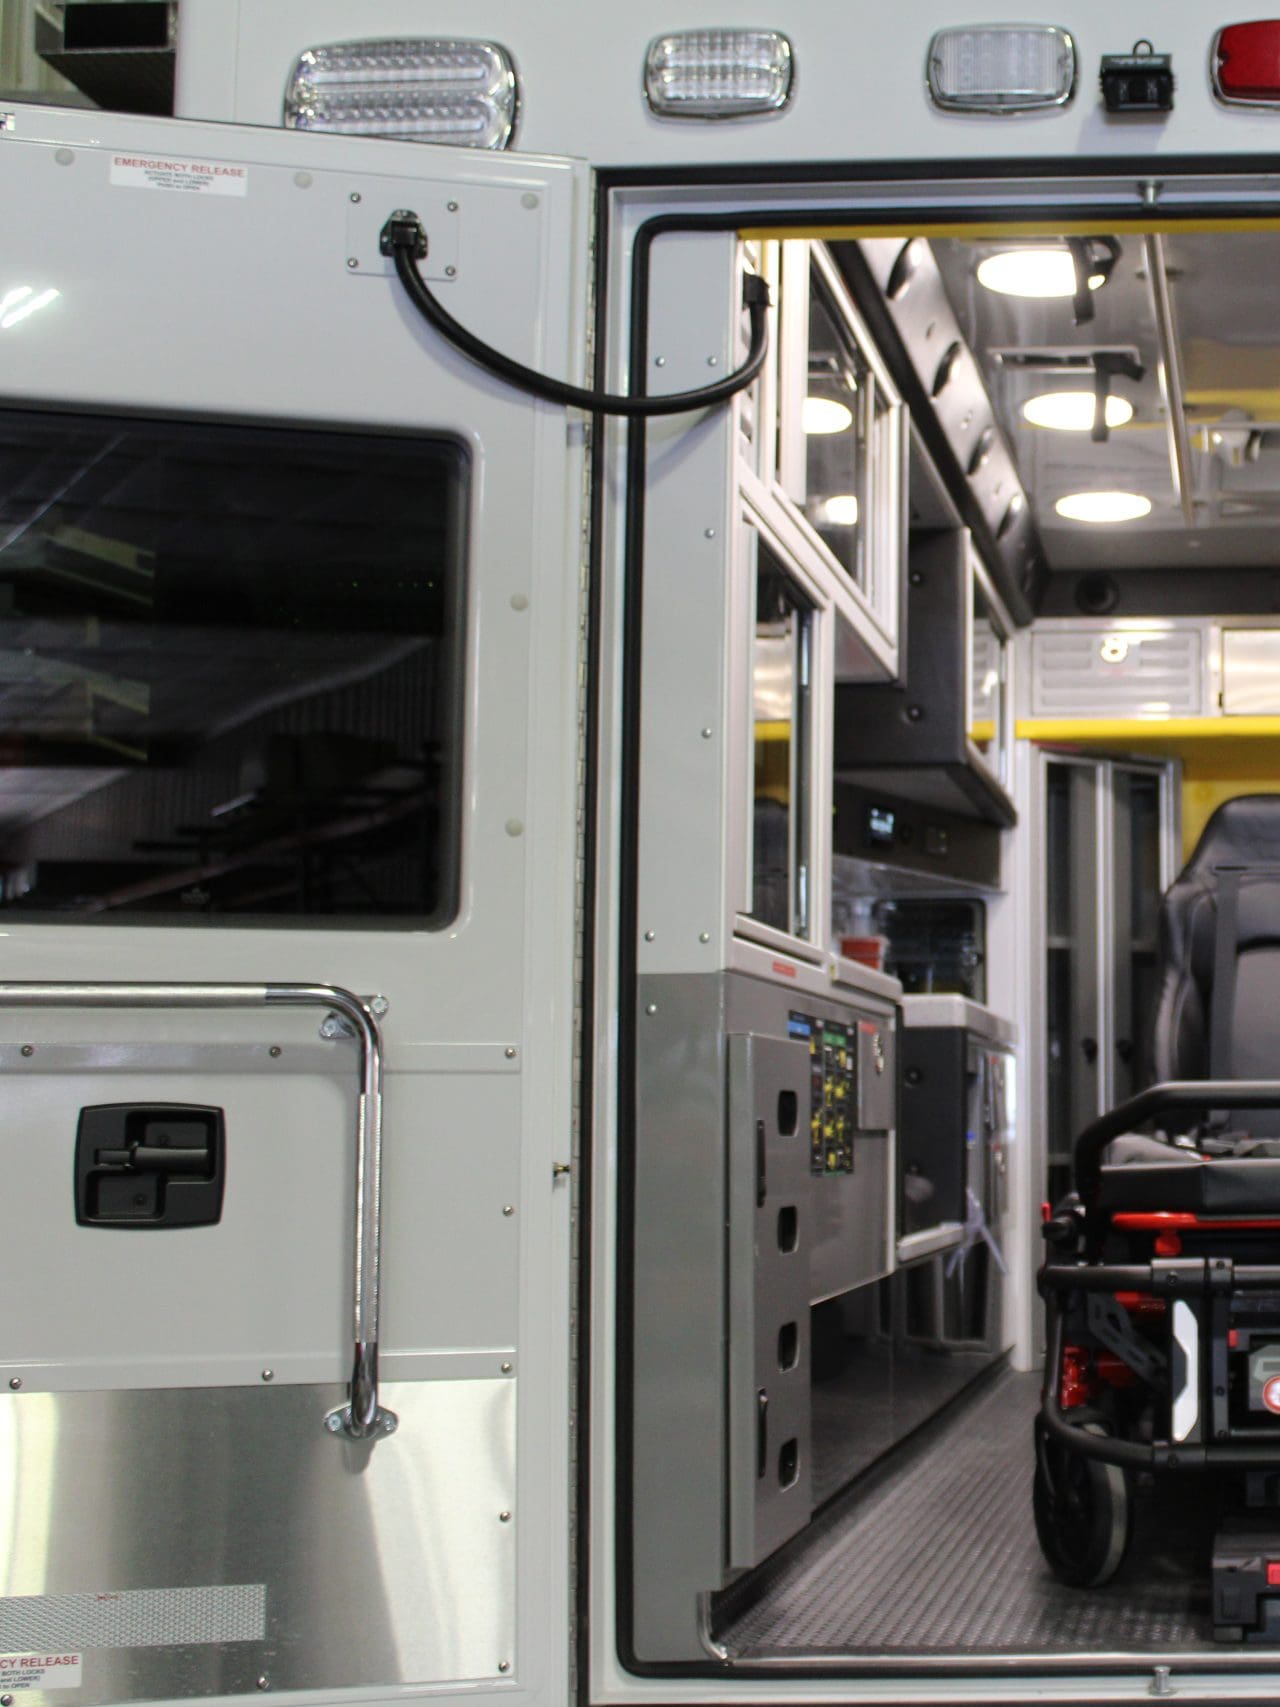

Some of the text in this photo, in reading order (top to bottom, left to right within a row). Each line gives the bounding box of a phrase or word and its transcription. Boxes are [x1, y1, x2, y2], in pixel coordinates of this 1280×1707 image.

[113, 157, 245, 178] EMERGENCY RELEASE
[20, 1655, 79, 1667] RELEASE
